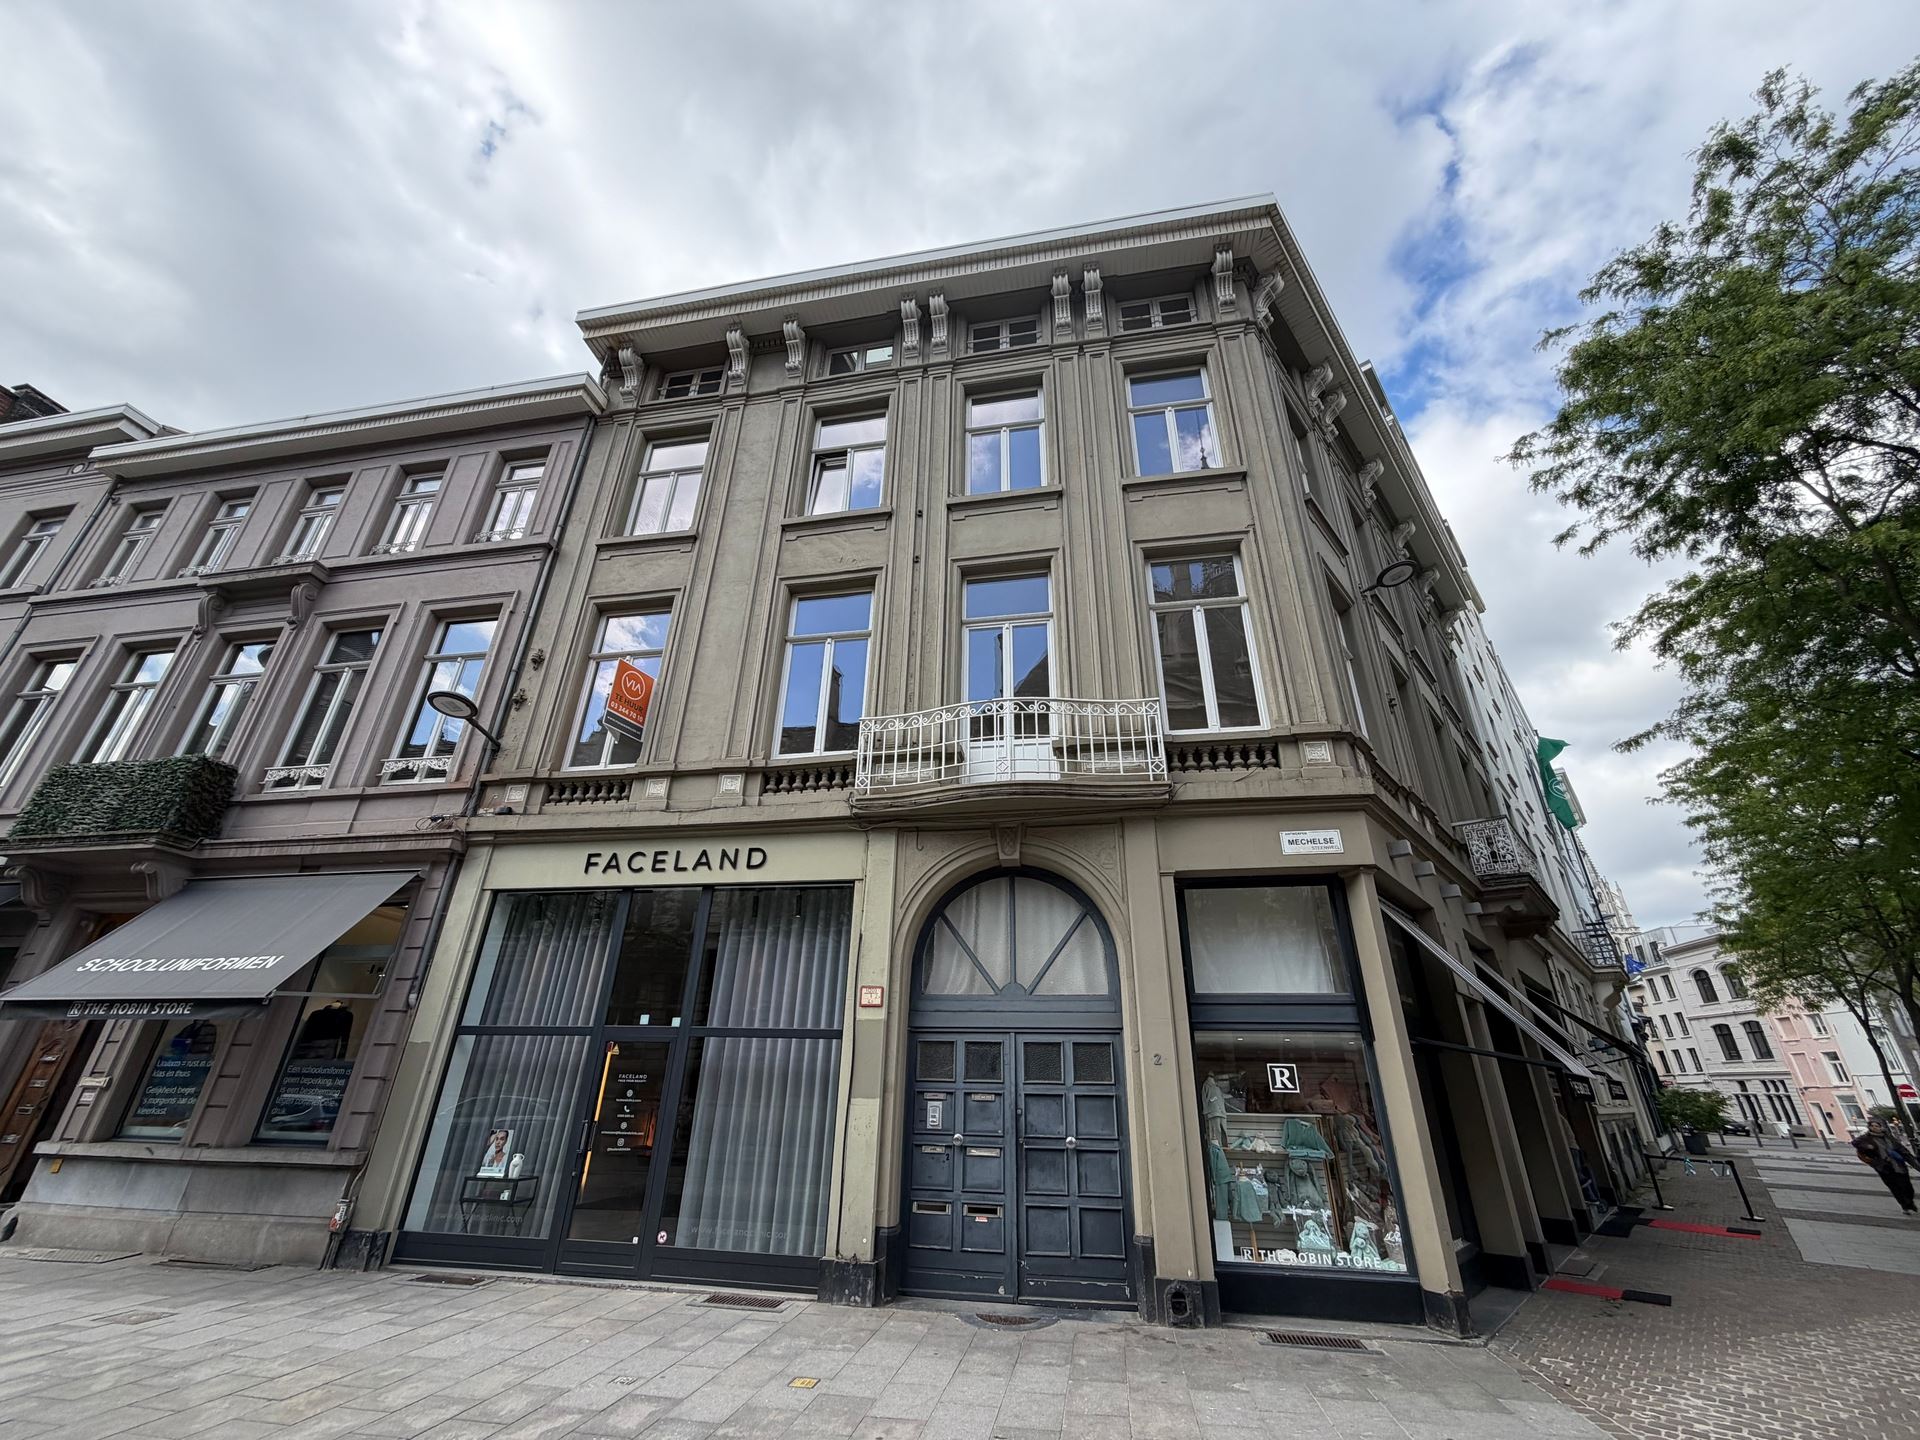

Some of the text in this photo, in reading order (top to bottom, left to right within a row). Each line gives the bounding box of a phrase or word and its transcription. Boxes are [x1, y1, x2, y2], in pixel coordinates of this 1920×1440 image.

[616, 693, 644, 714] TE HUUR
[1288, 838, 1335, 846] MECHELSE
[584, 847, 767, 875] FACELAND
[76, 955, 285, 972] SCHOOLUNIFORMEN
[83, 1003, 106, 1015] THE
[109, 1002, 150, 1015] ROBIN
[150, 1002, 194, 1015] STORE
[1153, 1053, 1163, 1066] 2
[1271, 1067, 1295, 1090] R
[1258, 1249, 1283, 1263] TH
[1336, 1254, 1382, 1268] STORE
